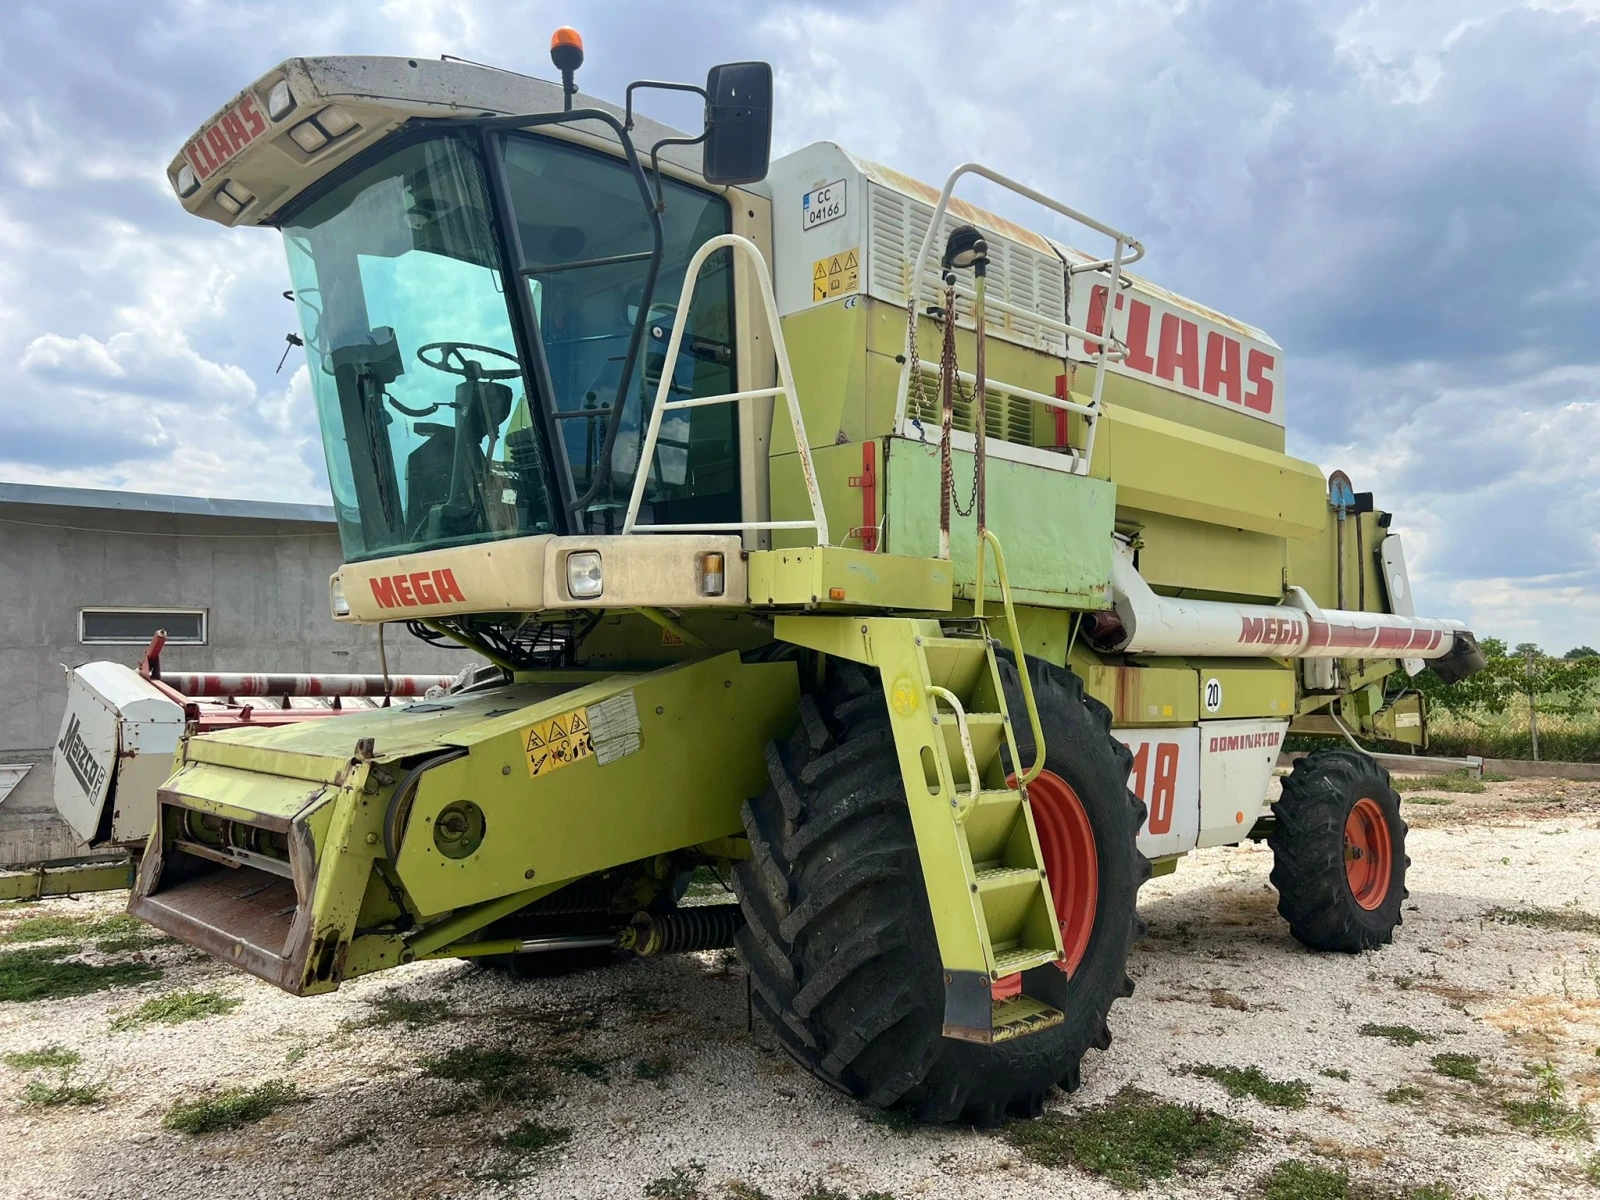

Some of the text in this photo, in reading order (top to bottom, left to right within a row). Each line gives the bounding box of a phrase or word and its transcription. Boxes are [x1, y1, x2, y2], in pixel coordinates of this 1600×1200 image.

[187, 94, 267, 180] CLAAS
[817, 189, 831, 204] CC
[809, 202, 840, 223] 04166
[1084, 284, 1275, 415] CLAAS
[369, 568, 467, 609] MEGA
[1238, 616, 1303, 645] MEGA
[1207, 683, 1219, 707] 20
[1209, 732, 1280, 753] DOMINATOR
[1123, 742, 1179, 836] 18
